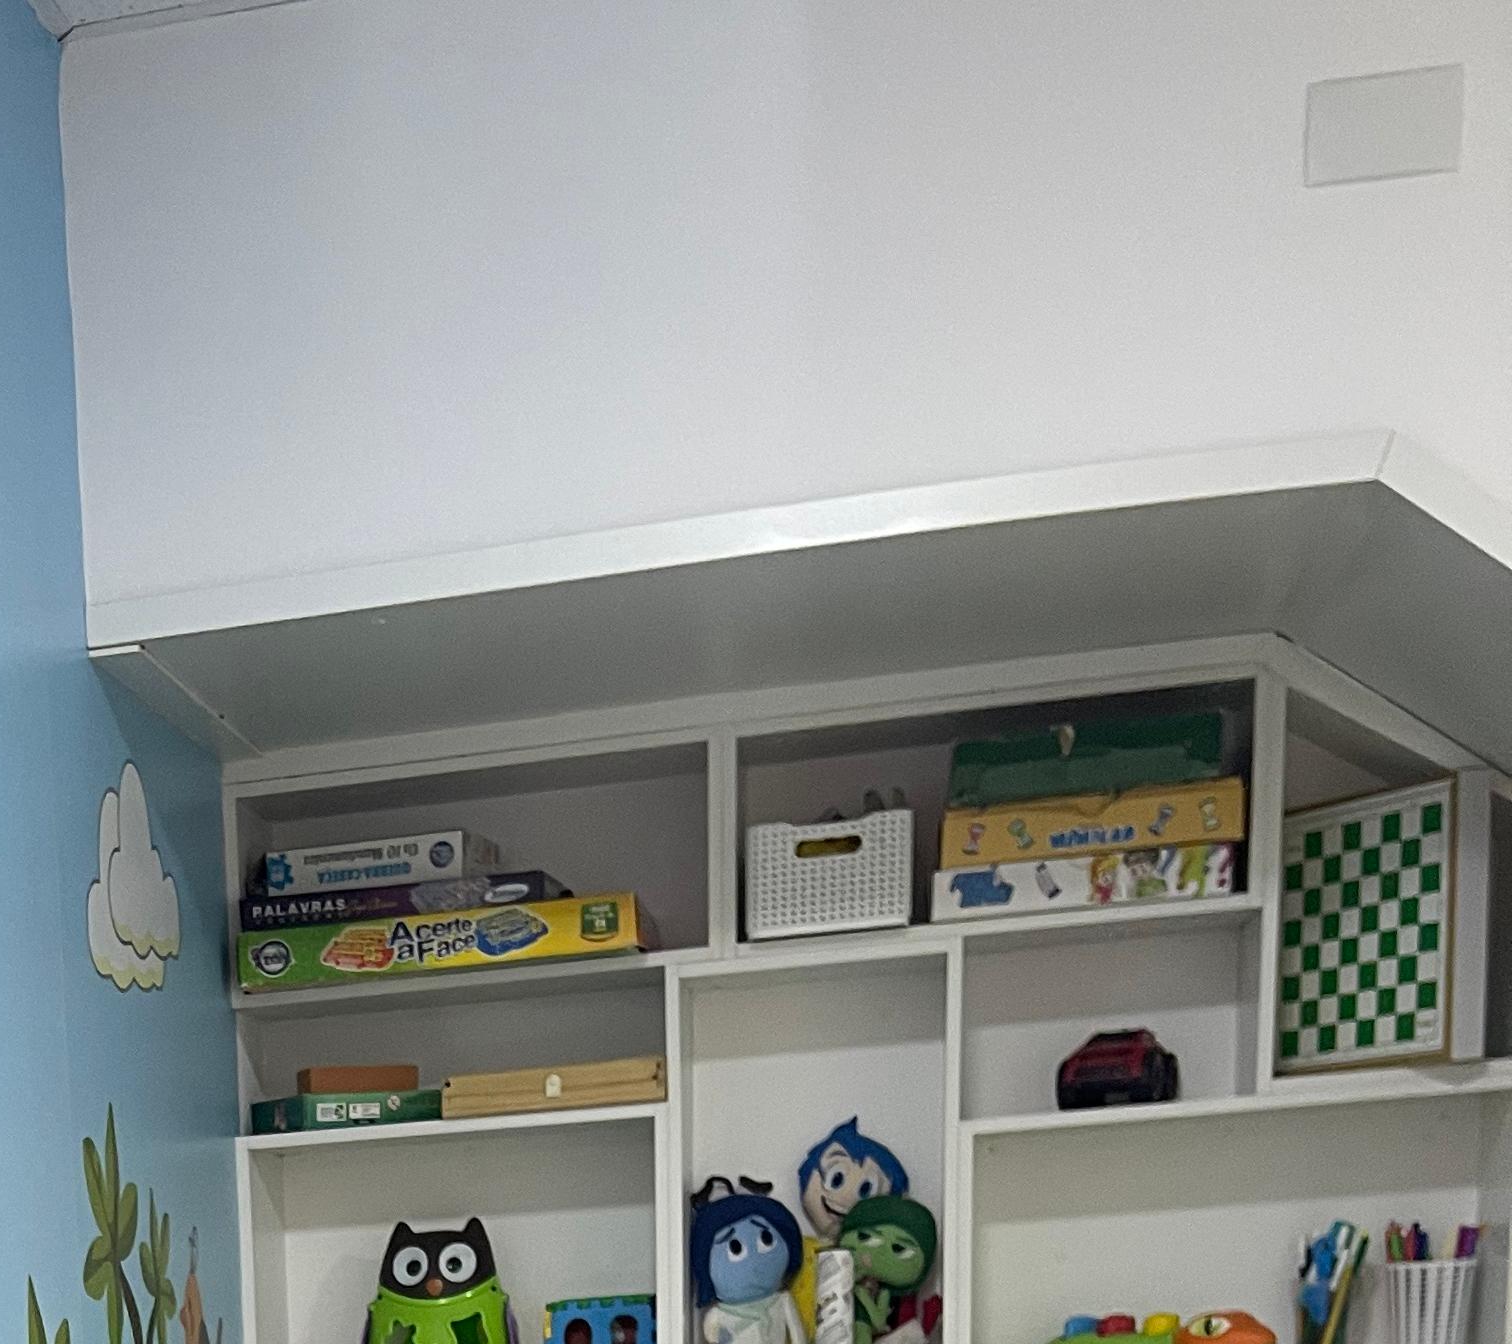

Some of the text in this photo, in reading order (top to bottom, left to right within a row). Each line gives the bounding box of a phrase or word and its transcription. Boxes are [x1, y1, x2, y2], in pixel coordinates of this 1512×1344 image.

[252, 898, 347, 919] PALAVRAS
[390, 921, 473, 946] Acerte
[416, 935, 475, 963] Face
